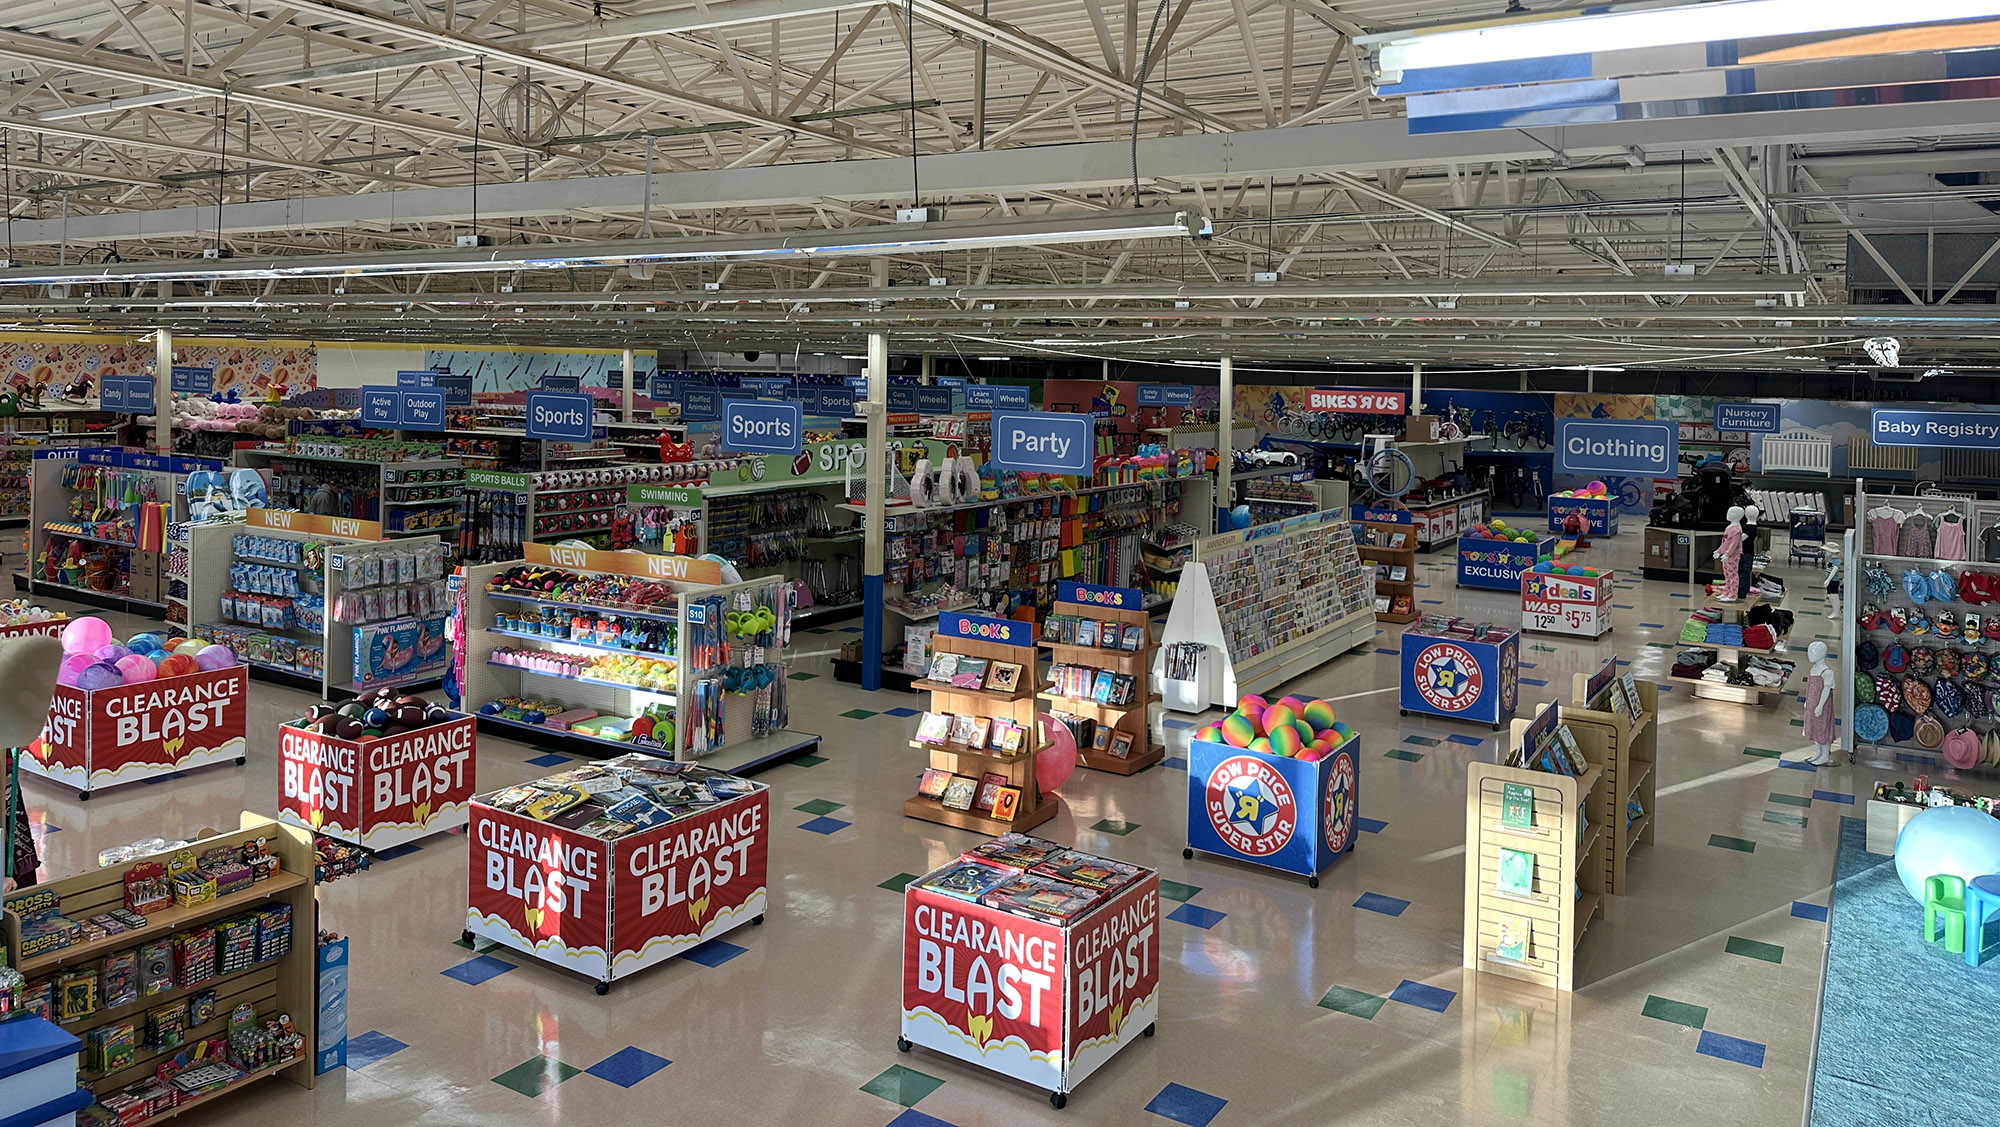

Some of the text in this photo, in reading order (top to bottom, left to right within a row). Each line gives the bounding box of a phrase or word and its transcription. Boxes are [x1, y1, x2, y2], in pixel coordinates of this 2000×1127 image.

[104, 388, 122, 400] Candy
[130, 390, 150, 399] Seasonal
[454, 386, 468, 396] Toys
[689, 394, 710, 402] Stuffed
[1167, 391, 1189, 399] Wheels
[372, 397, 392, 406] Active
[408, 398, 436, 408] Outdoor
[822, 396, 850, 406] Sports
[894, 398, 912, 406] Trucks
[920, 396, 947, 404] Wheels
[974, 397, 994, 405] Create
[1000, 395, 1024, 404] Wheels
[1310, 394, 1398, 411] BIKES US
[374, 408, 388, 418] Play
[414, 408, 429, 420] Play
[688, 404, 712, 412] Animals
[1724, 408, 1768, 420] Nursery
[536, 406, 584, 427] Sports
[1722, 416, 1770, 428] Furniture
[732, 415, 791, 438] Sports
[1878, 420, 1999, 439] Baby Registry
[1012, 430, 1071, 458] Party
[1568, 437, 1665, 462] Clothing
[48, 451, 78, 460] OUT
[470, 473, 525, 487] SPORTS BALLS
[518, 495, 527, 504] D2
[640, 489, 688, 502] SWIMMING
[265, 511, 291, 528] NEW
[1552, 506, 1577, 515] TOYS
[1591, 508, 1606, 518] US
[332, 518, 360, 536] NEW
[1554, 516, 1603, 528] EXIVE
[1254, 526, 1278, 539] BIRTHDAY
[1678, 536, 1689, 544] G1
[1206, 535, 1237, 550] ANNIVERSARY
[550, 548, 587, 568] NEW
[1462, 550, 1534, 566] TOYS US
[648, 557, 688, 578] NEW
[1464, 566, 1522, 580] EXCLUSIV
[1076, 588, 1123, 606] BOOKS
[1549, 583, 1592, 600] deals
[690, 608, 702, 619] S10
[1525, 600, 1561, 614] WAS
[376, 622, 416, 635] PINK FLAMINGO
[958, 618, 1010, 640] BOOKS
[1418, 648, 1478, 677] LOW PRICE
[106, 678, 239, 718] CLEARANCE
[1417, 675, 1480, 710] SUPER STAR
[117, 698, 230, 746] BLAST
[282, 733, 355, 774] CLEARANCE
[370, 724, 472, 772] CLEARANCE
[284, 760, 353, 814] BLAST
[374, 750, 470, 813] BLAST
[1211, 762, 1291, 807] LOW PRICE
[1210, 801, 1292, 852] SUPER STAR
[630, 803, 762, 877] CLEARANCE
[478, 818, 598, 881] CLEARANCE
[486, 850, 590, 919] BLAST
[641, 836, 754, 918] BLAST
[1075, 890, 1156, 970] CLEARANCE
[914, 905, 1056, 974] CLEARANCE
[918, 938, 1051, 1028] BLAST
[1078, 922, 1154, 1028] BLAST
